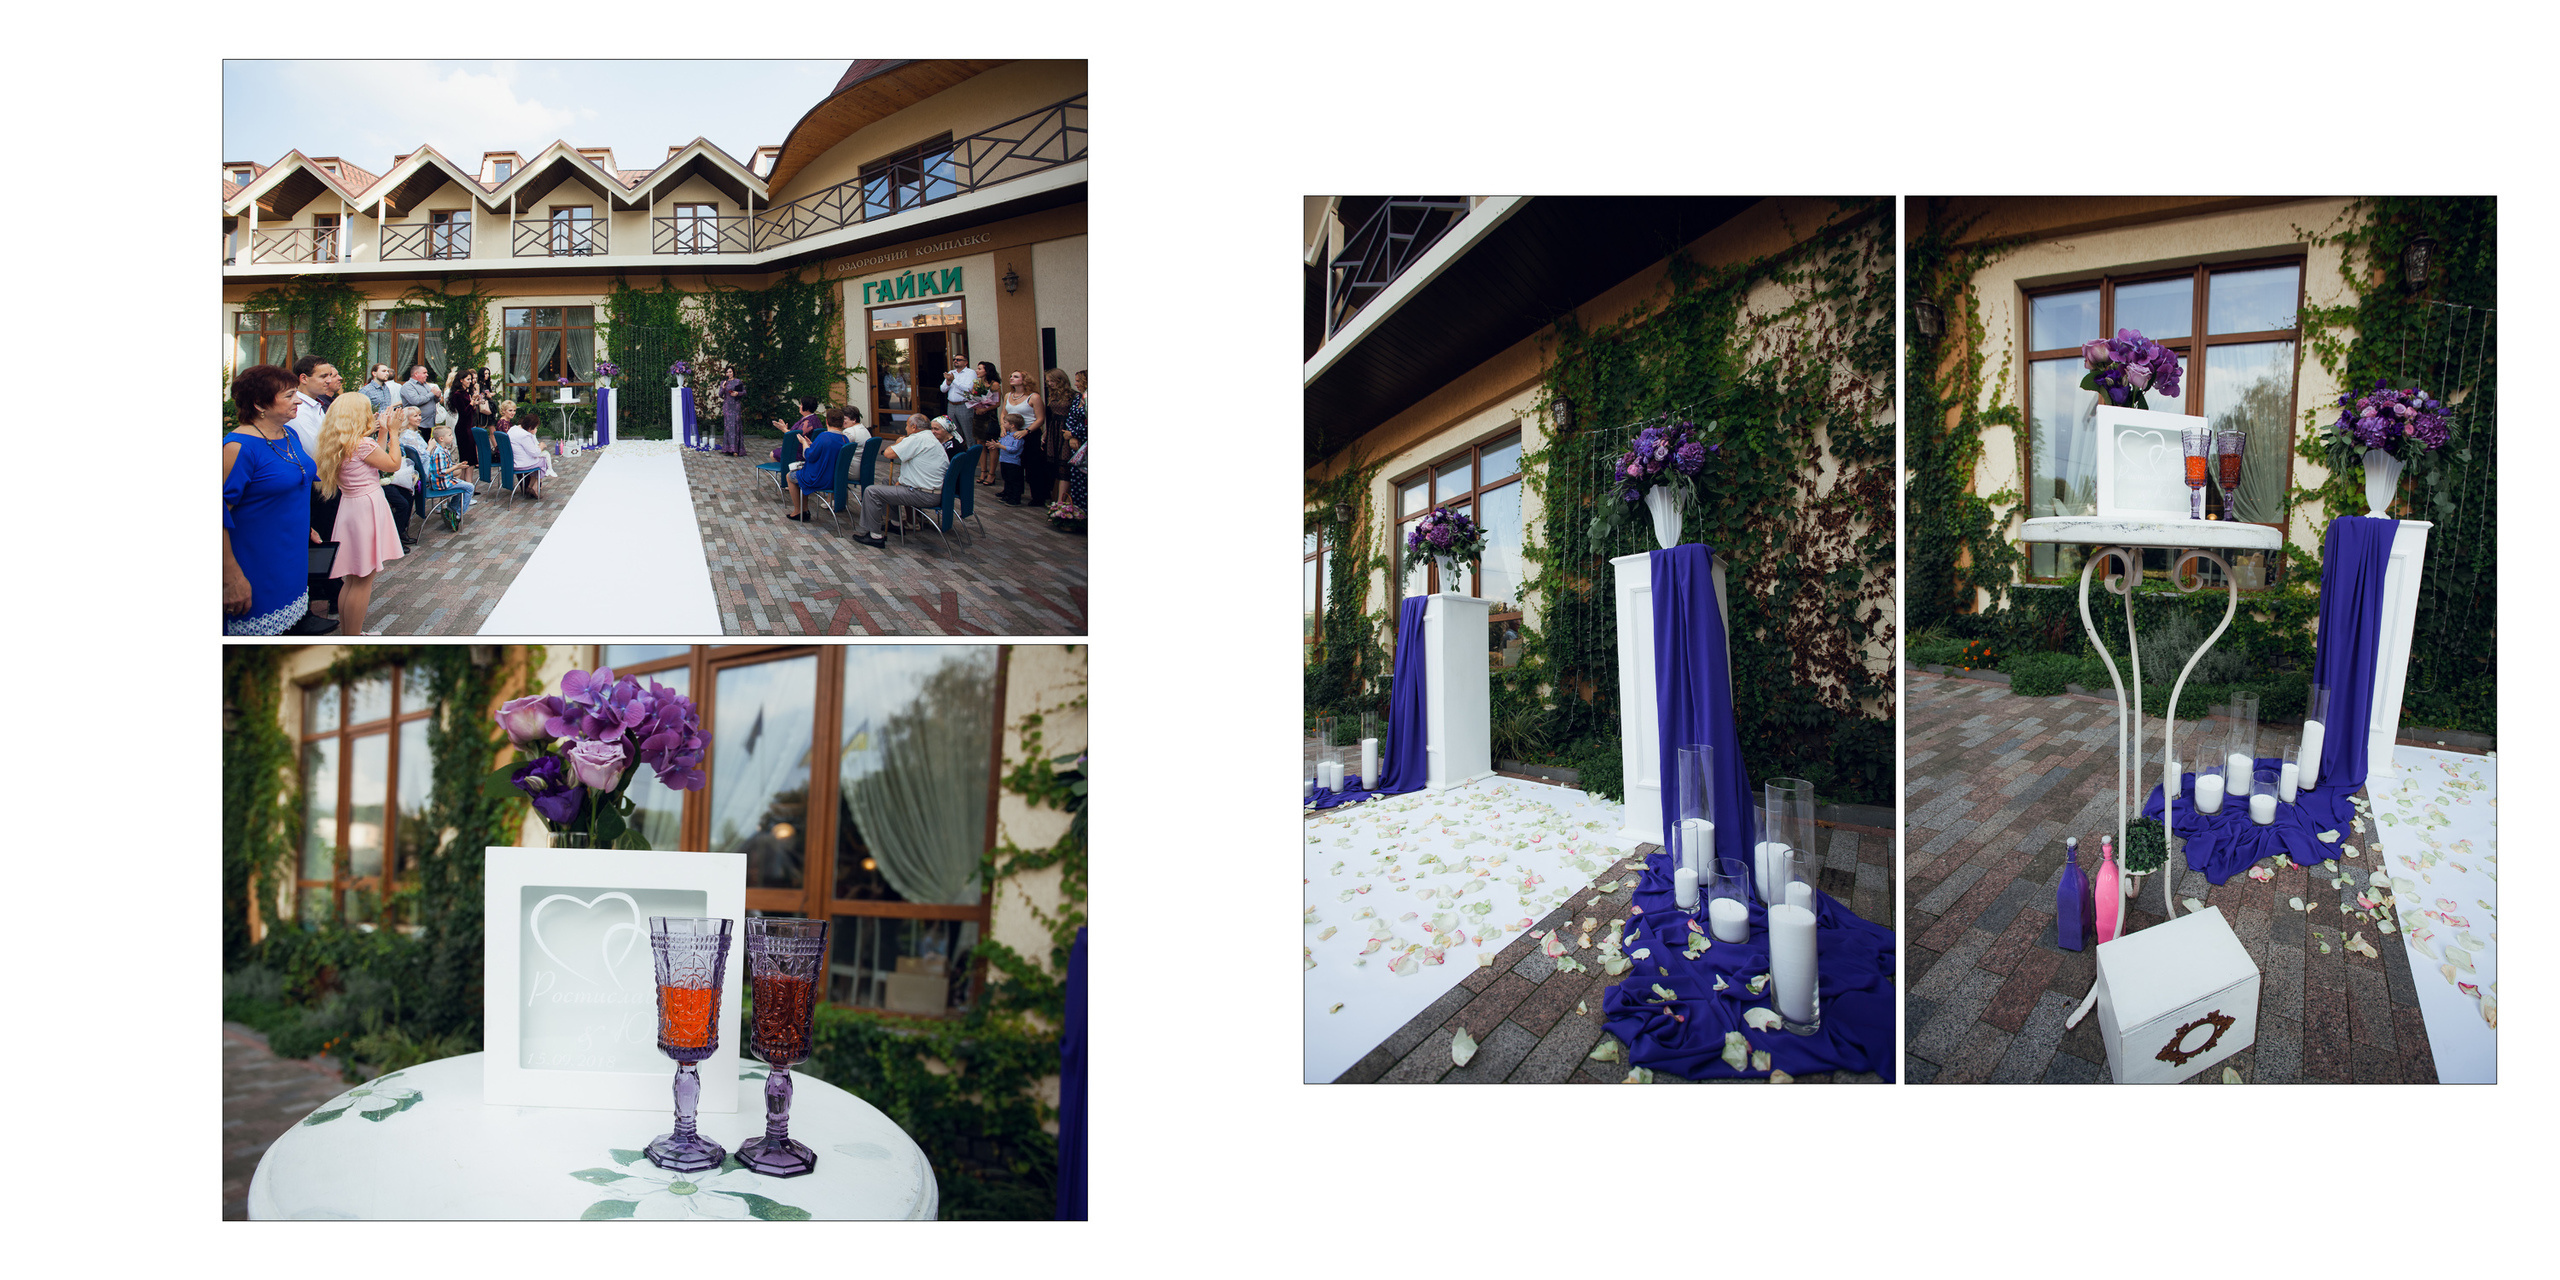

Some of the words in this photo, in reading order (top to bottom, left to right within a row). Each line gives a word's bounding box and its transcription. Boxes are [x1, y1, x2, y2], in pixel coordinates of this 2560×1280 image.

[837, 248, 908, 272] ОЗДОРОВЧИЙ
[915, 232, 991, 256] КОМПЛЕКС
[863, 266, 964, 305] ГАЙКИ
[527, 1051, 617, 1069] 15.09.2018
